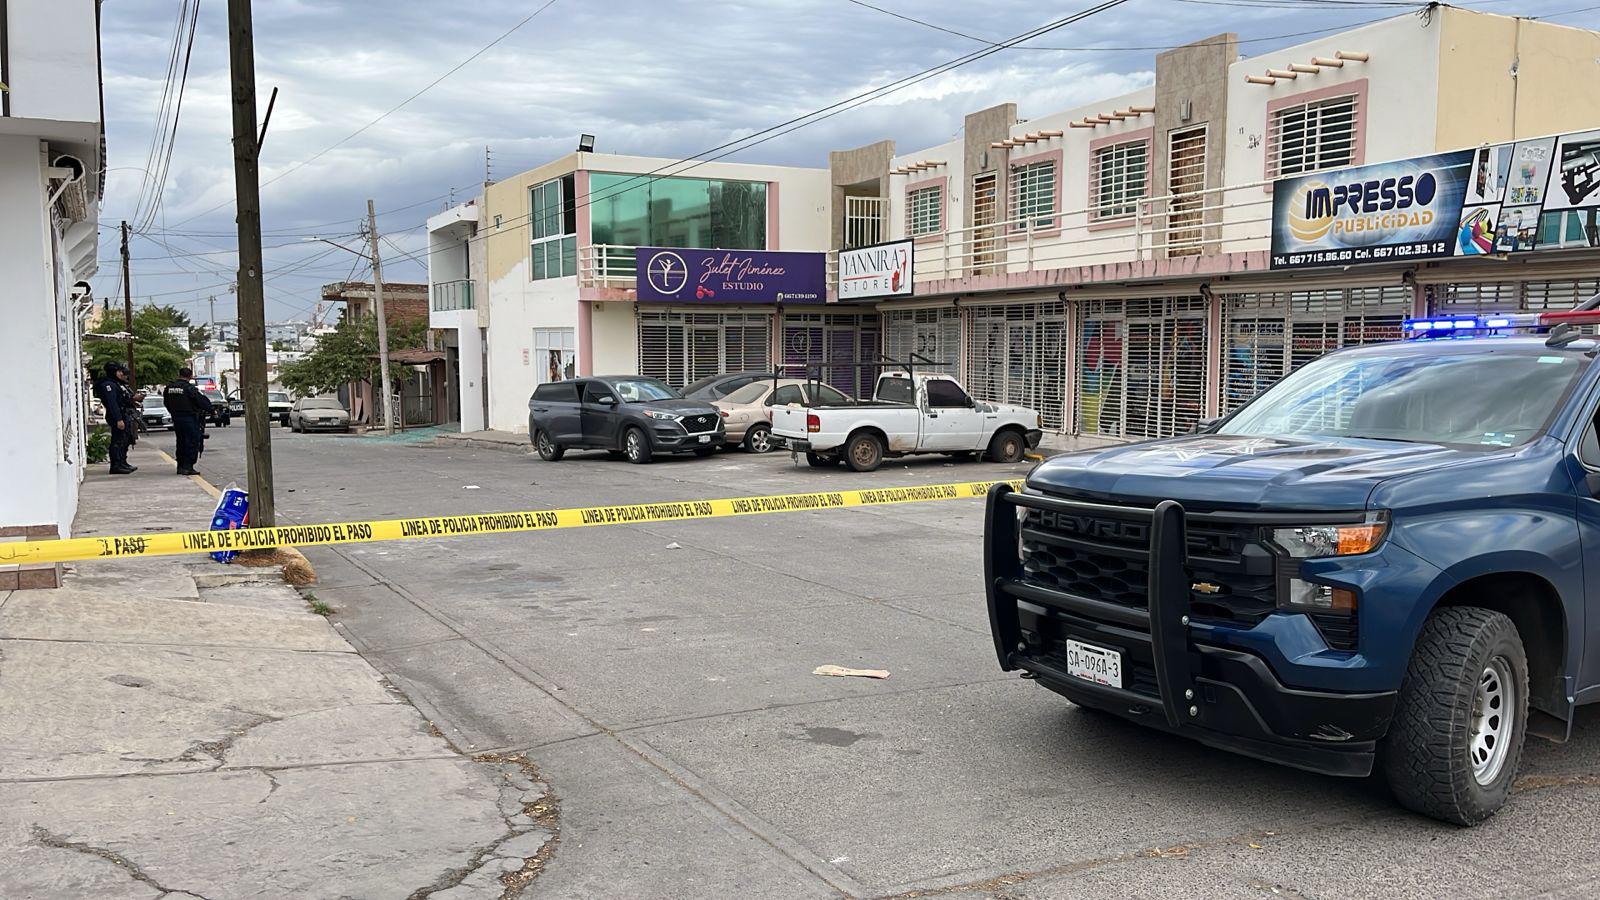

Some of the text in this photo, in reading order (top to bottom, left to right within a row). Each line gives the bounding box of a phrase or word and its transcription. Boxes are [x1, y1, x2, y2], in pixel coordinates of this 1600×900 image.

[1306, 172, 1436, 220] IMPRESSO
[700, 253, 785, 283] Zulet Jiménez
[843, 248, 900, 276] YANNIRA
[1274, 257, 1287, 265] Tel.
[1355, 250, 1371, 259] Cel.
[722, 282, 764, 290] ESTUDIO
[843, 278, 889, 292] STORE
[731, 493, 844, 513] LINEA DE POLICIA PROHIBIDO EL PASO
[859, 485, 956, 503] LINEA DE POLICIA PROHIBIDO EL PASO
[580, 502, 713, 523] LINEA DE POLICIA PROHIBIDO EL PASO
[400, 512, 558, 536] LINEA DE POLICIA PROHIBIDO EL PASO
[1026, 508, 1240, 549] CHEVROET
[115, 537, 145, 555] PASO
[182, 523, 372, 549] LINEA DE POLICIA PROHIBIDO EL PASO
[1069, 650, 1118, 678] SA-096A-3
